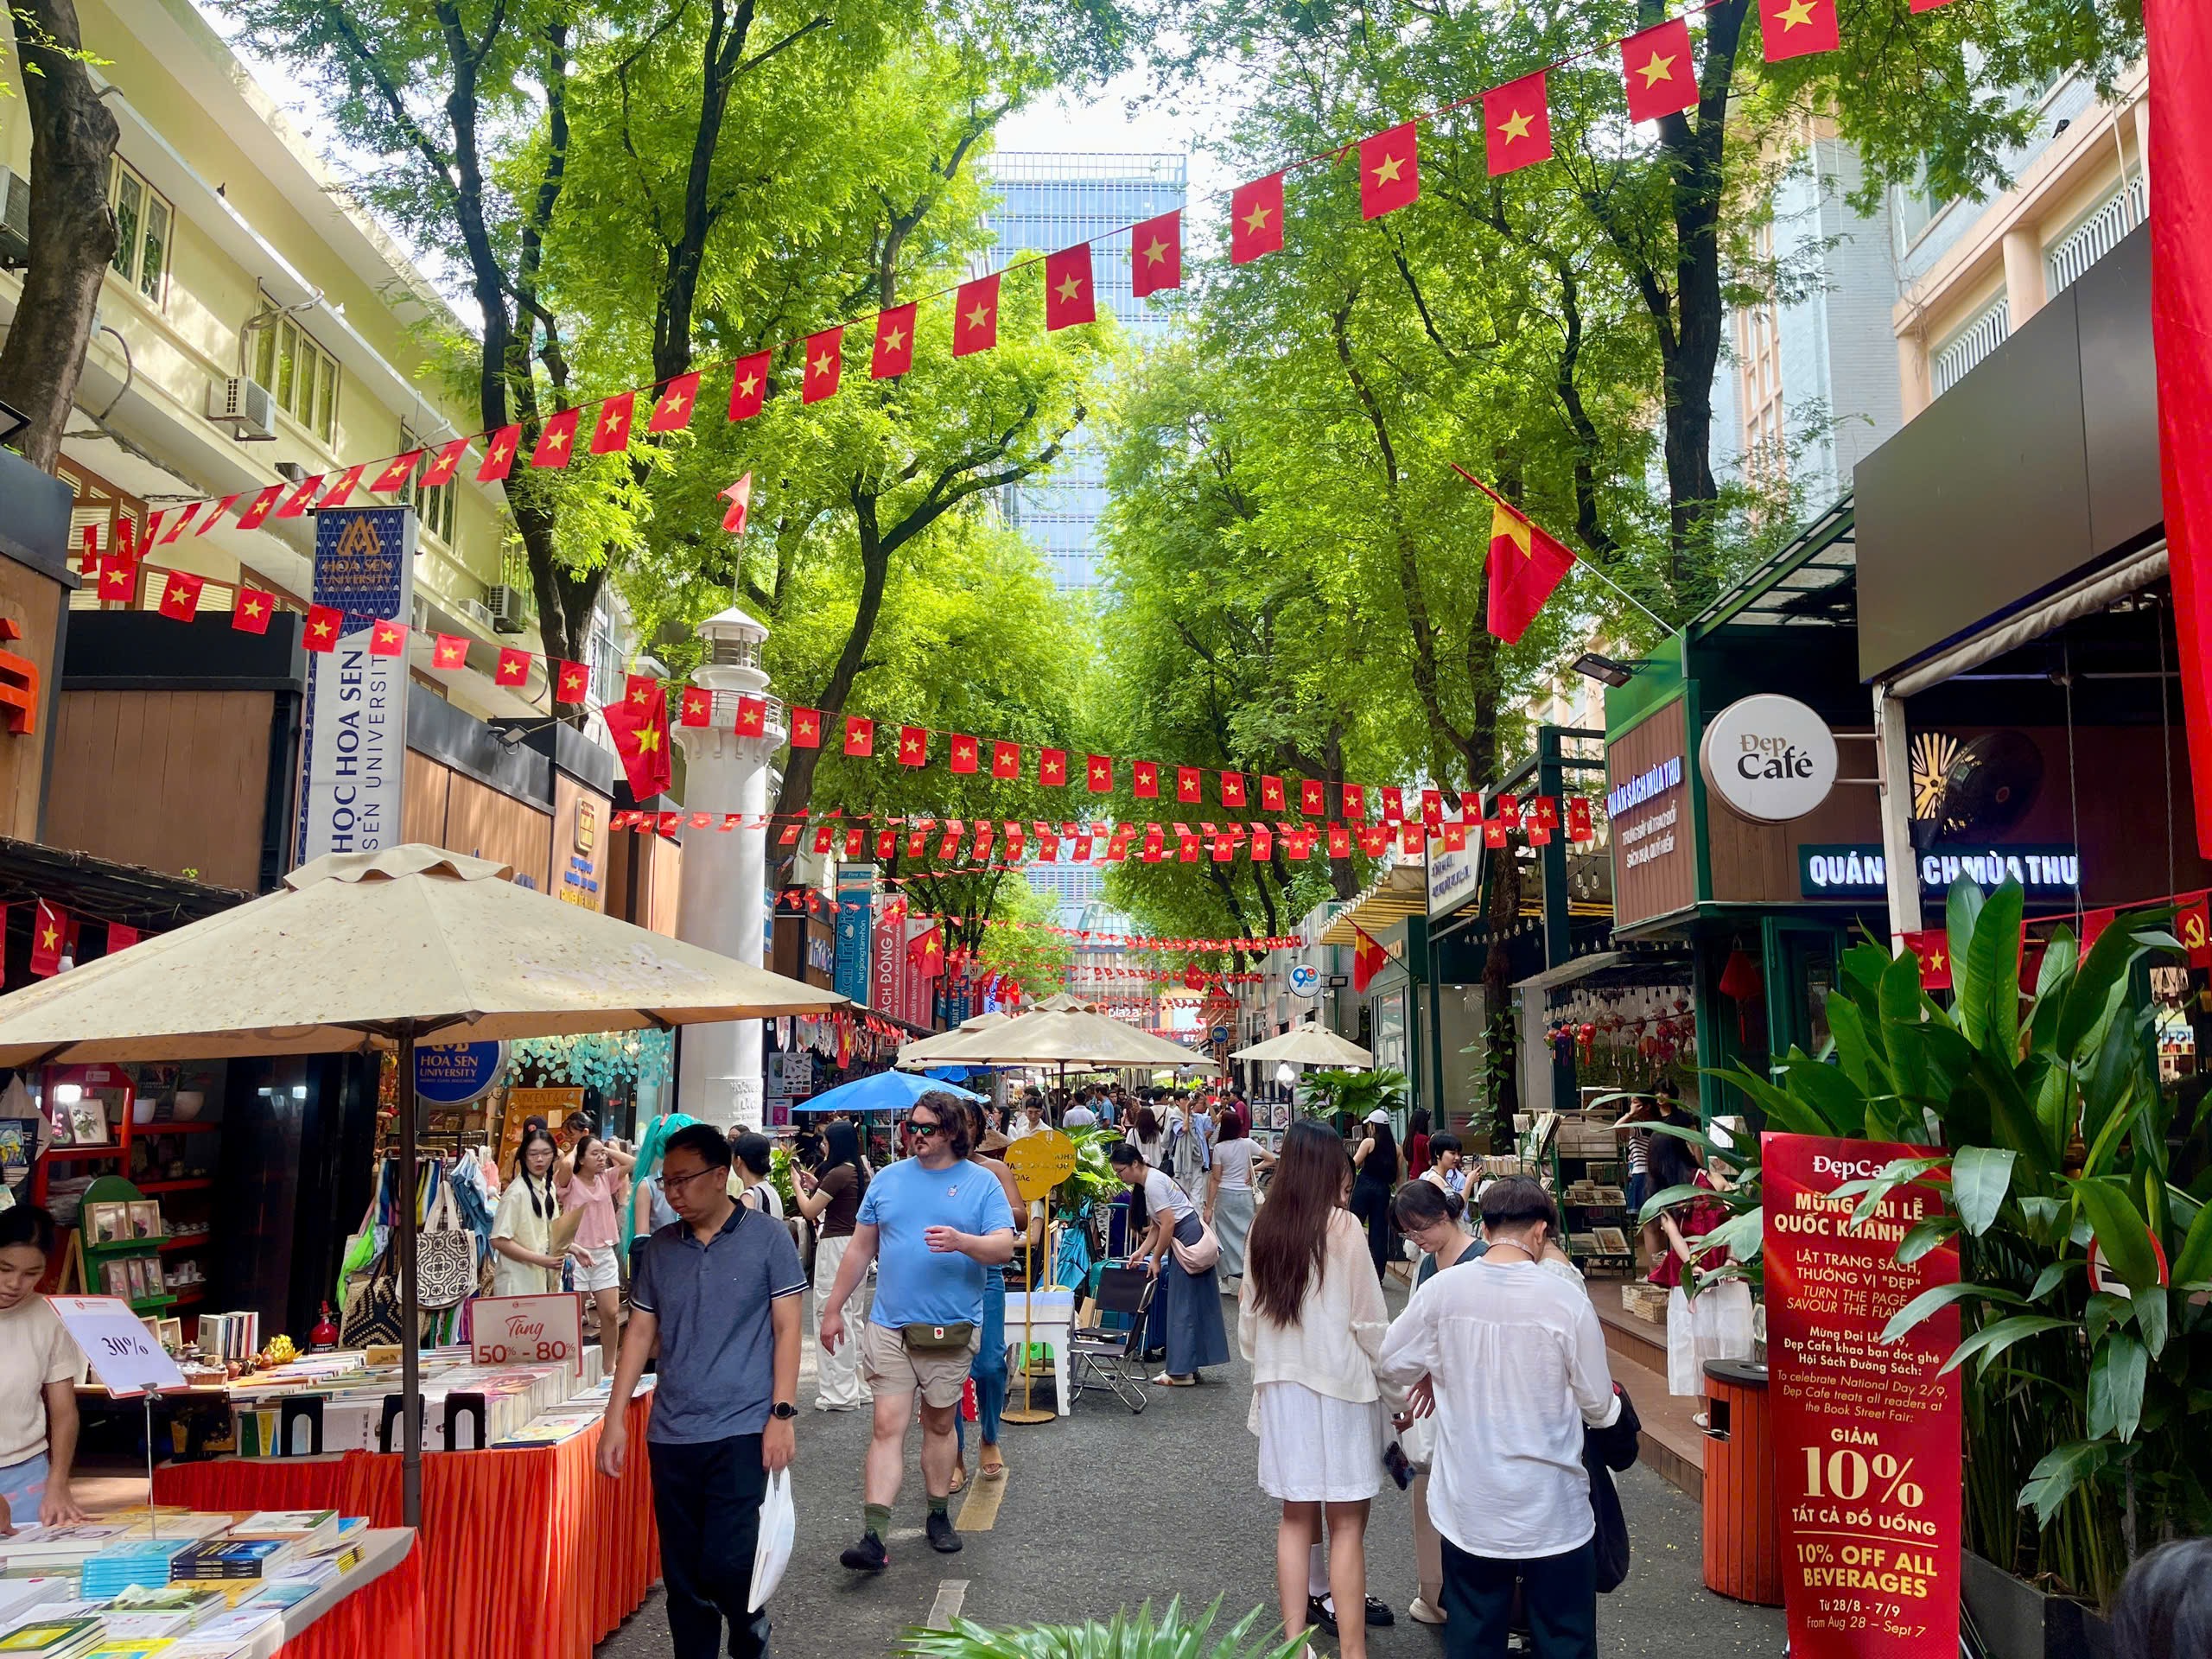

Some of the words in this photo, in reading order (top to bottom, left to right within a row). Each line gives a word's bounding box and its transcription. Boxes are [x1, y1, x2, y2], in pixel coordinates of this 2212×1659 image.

[322, 559, 360, 572] HOA
[365, 559, 392, 571] SEN
[322, 575, 391, 584] UNIVERSITY
[340, 651, 363, 701] SEN
[365, 655, 387, 788] UNIVERSIT
[335, 710, 360, 776] HOA
[1739, 734, 1787, 758] Đẹp
[1738, 746, 1814, 779] Café
[1607, 784, 1627, 819] QUÁN
[1627, 775, 1647, 808] SÁCH
[1646, 764, 1664, 798] MÙA
[1663, 756, 1681, 788] THU
[331, 785, 361, 853] HỌC
[362, 804, 380, 850] SEN
[1809, 850, 1885, 887] QUÁN
[1961, 850, 2024, 885] MÙA
[2024, 855, 2079, 885] THU
[877, 938, 893, 985] ĐÔNG
[878, 988, 893, 1014] ÁCH
[949, 1007, 960, 1026] XUẤT
[419, 1068, 477, 1077] UNIVERSITY
[421, 1055, 450, 1066] HOA
[454, 1056, 479, 1067] SEN
[1904, 1197, 1923, 1220] LỄ
[1774, 1212, 1829, 1236] QUỐC
[1796, 1249, 1819, 1265] LẬT
[1824, 1253, 1873, 1269] TRANG
[1878, 1256, 1922, 1276] SÁCH,
[1796, 1267, 1858, 1285] THƯỞNG
[1862, 1274, 1876, 1288] VỊ
[1882, 1275, 1921, 1292] "ĐẸP"
[1786, 1297, 1837, 1313] SAVOUR
[1843, 1302, 1867, 1317] THE
[1802, 1285, 1838, 1300] TURN
[1843, 1288, 1867, 1303] THE
[1872, 1292, 1907, 1306] PAGE
[505, 1314, 545, 1342] Tặng
[1809, 1325, 1840, 1341] Mừng
[1844, 1329, 1863, 1342] Đại
[100, 1335, 149, 1357] 30%
[479, 1344, 517, 1364] 50%
[536, 1340, 575, 1360] 80%
[1783, 1338, 1804, 1352] Đẹp
[1807, 1342, 1832, 1352] Cafe
[1835, 1342, 1864, 1356] khao
[1867, 1344, 1889, 1359] bạn
[1893, 1348, 1914, 1363] đọc
[1917, 1351, 1940, 1366] ghé
[1798, 1353, 1816, 1367] Hội
[1820, 1354, 1847, 1369] Sách
[1850, 1358, 1887, 1375] Đường
[1891, 1363, 1923, 1376] Sách:
[1777, 1370, 1787, 1382] To
[1789, 1371, 1837, 1385] celebrate
[1840, 1376, 1889, 1391] National
[1892, 1380, 1916, 1395] Day
[1919, 1384, 1948, 1400] 2/9,
[1783, 1384, 1802, 1399] Đẹp
[1805, 1386, 1831, 1398] Cafe
[1834, 1390, 1863, 1402] treats
[1866, 1392, 1881, 1404] all
[1884, 1395, 1927, 1410] readers
[1930, 1401, 1943, 1412] at
[1805, 1401, 1821, 1413] the
[1824, 1402, 1851, 1416] Book
[1854, 1406, 1885, 1420] Street
[1889, 1409, 1914, 1423] Fair:
[1830, 1426, 1878, 1446] GIẢM
[1801, 1446, 1923, 1508] 10%
[1792, 1503, 1815, 1522] TẤT
[1819, 1505, 1840, 1523] CẢ
[1845, 1508, 1872, 1527] ĐỒ
[1878, 1512, 1937, 1536] UỐNG
[1796, 1543, 1834, 1563] 10%
[1840, 1545, 1886, 1567] OFF
[1894, 1552, 1938, 1577] ALL
[1802, 1567, 1928, 1599] BEVERAGES
[1819, 1599, 1830, 1611] Từ
[1833, 1599, 1861, 1613] 28/8
[1874, 1602, 1901, 1618] 7/9
[1807, 1616, 1826, 1629] From
[1827, 1615, 1847, 1631] Aug
[1849, 1616, 1866, 1629] 28
[1884, 1620, 1912, 1638] Sept
[1915, 1625, 1927, 1637] 7
